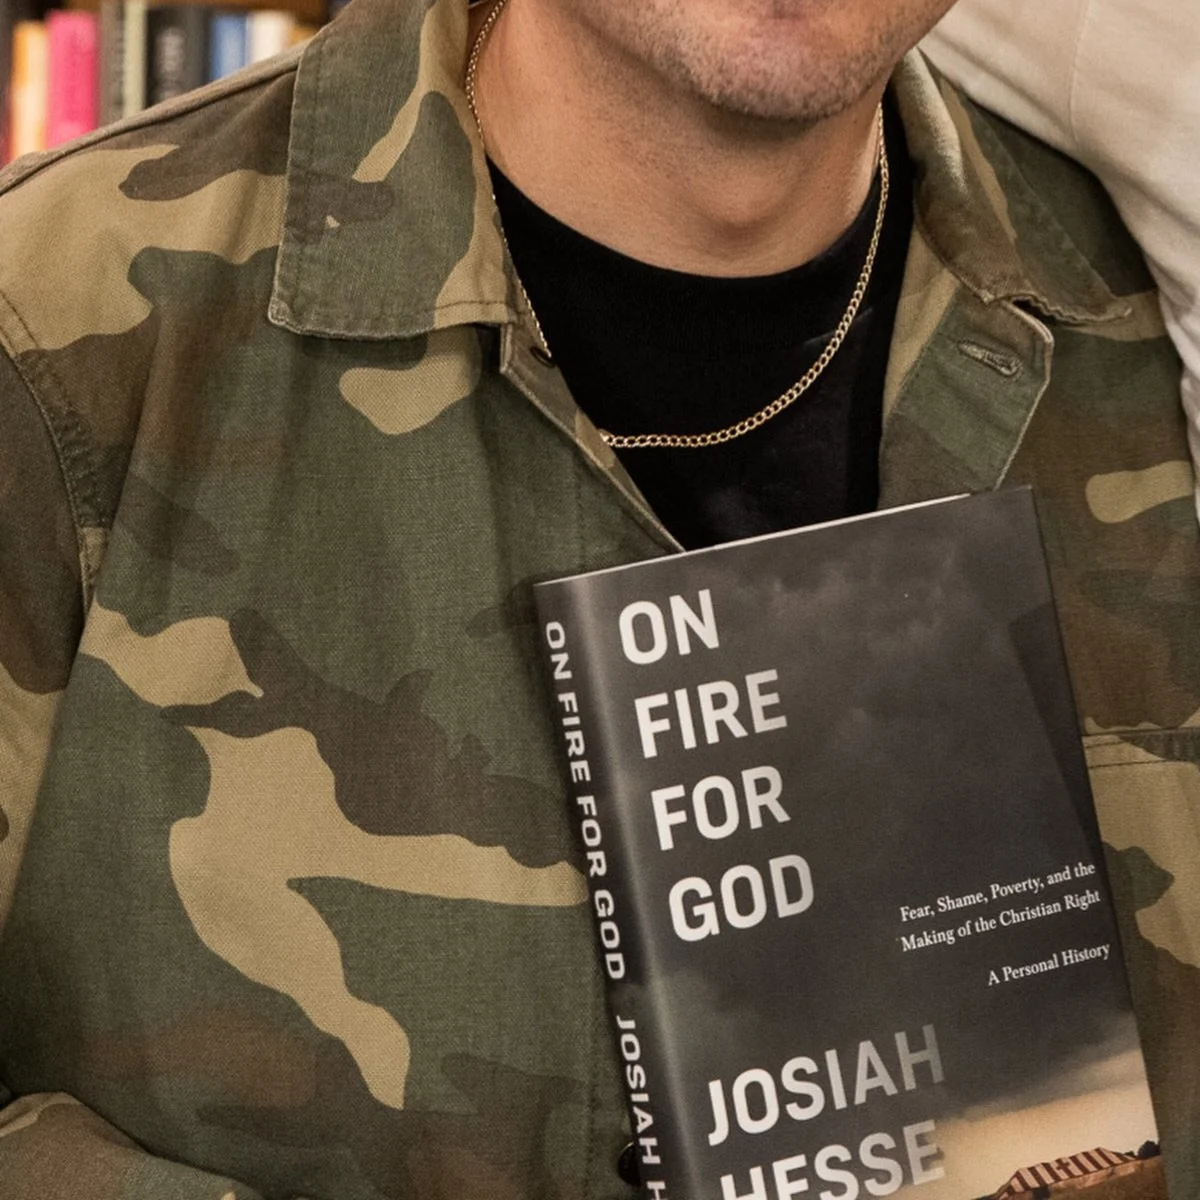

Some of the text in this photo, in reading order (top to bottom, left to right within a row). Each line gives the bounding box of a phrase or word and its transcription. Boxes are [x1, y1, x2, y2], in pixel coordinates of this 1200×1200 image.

[546, 621, 573, 680] ON
[619, 589, 720, 665] ON
[558, 692, 592, 783] FIRE
[634, 669, 788, 759] FIRE
[577, 796, 608, 878] FOR
[650, 765, 791, 851] FOR
[668, 853, 816, 942] GOD
[900, 861, 1096, 922] Fear, Shame, Poverty, and the
[901, 890, 1101, 952] Making of the Christian Right
[595, 889, 626, 980] GOD
[988, 944, 1110, 986] A Personal History
[616, 1014, 662, 1165] JOSIAH
[708, 1024, 945, 1146] JOSIAH
[720, 1119, 946, 1200] HESSE
